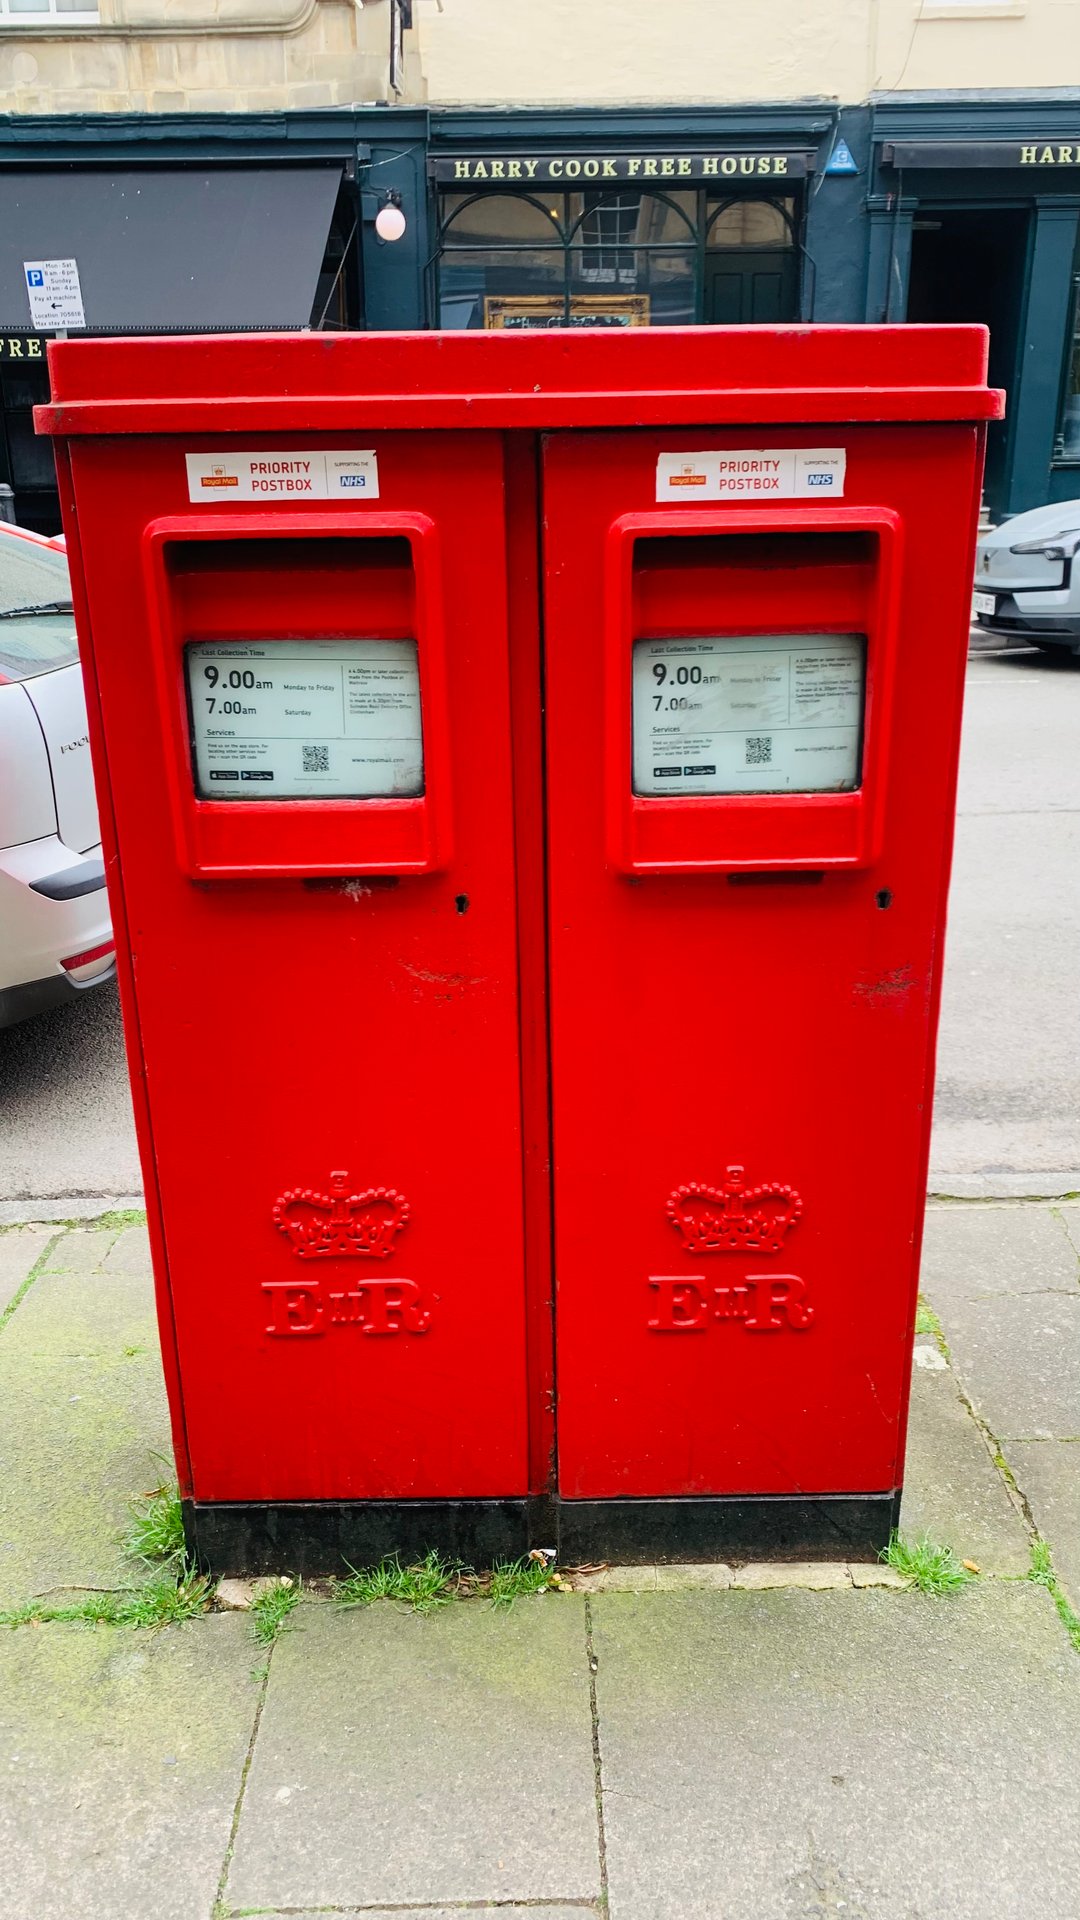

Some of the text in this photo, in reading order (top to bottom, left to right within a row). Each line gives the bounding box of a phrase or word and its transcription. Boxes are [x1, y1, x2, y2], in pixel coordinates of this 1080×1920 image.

[1020, 145, 1080, 164] HAR
[454, 157, 788, 178] HARRY COOK FREE HOUSE
[31, 271, 41, 286] P
[250, 461, 311, 474] PRIORITY
[719, 460, 780, 473] PRIORITY
[202, 477, 237, 487] Royal Mail
[252, 479, 312, 492] POSTBOX
[341, 476, 364, 486] NHS
[671, 477, 689, 485] Royal
[719, 478, 780, 490] POSTBOX
[809, 475, 832, 485] NHS
[651, 646, 664, 654] Last
[204, 665, 273, 689] 9.00am
[652, 663, 720, 686] 9.00am
[205, 698, 257, 715] 7.00am
[652, 695, 703, 712] 7.00am
